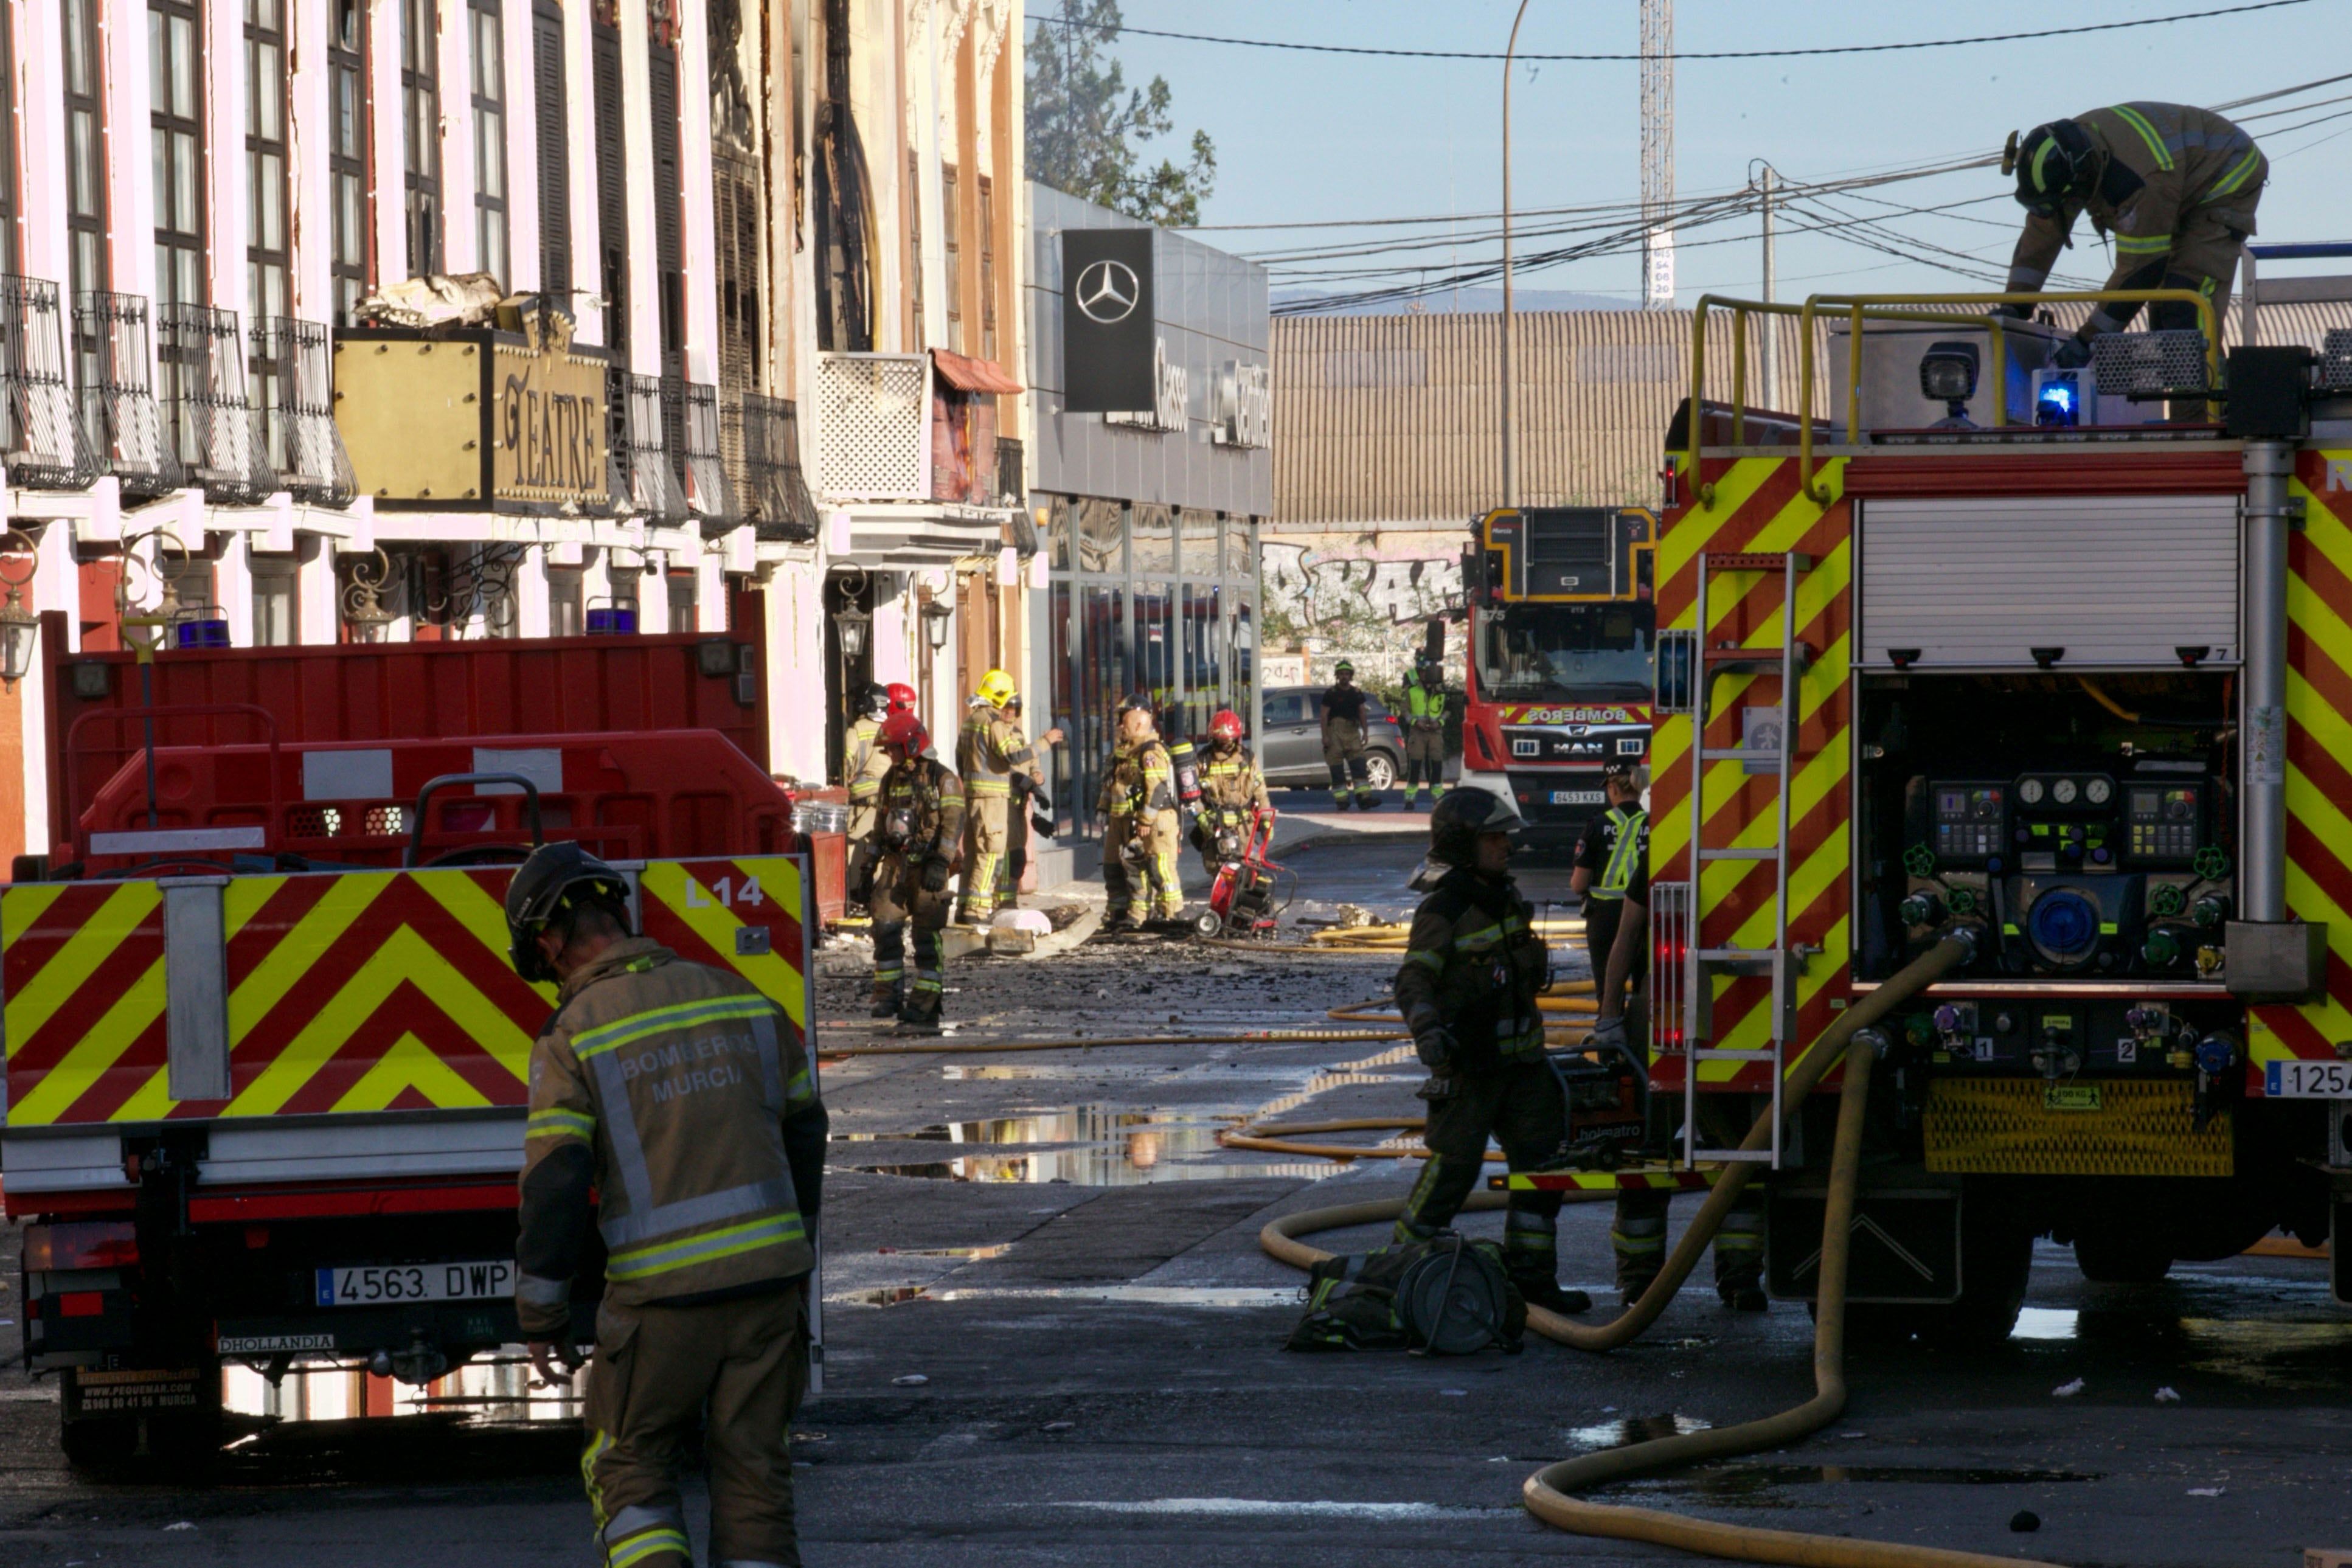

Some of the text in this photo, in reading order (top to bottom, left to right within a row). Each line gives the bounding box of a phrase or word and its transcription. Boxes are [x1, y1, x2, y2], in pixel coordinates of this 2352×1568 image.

[504, 364, 597, 493] TEATRE
[1479, 610, 1505, 622] E75
[2216, 649, 2227, 660] 7
[1553, 743, 1603, 754] MAN
[1556, 792, 1601, 802] 6453 KXS
[685, 876, 763, 908] L14
[1979, 1041, 1988, 1057] 1
[2121, 1042, 2132, 1058] 2
[341, 1269, 425, 1301] 4563
[446, 1266, 508, 1297] DWP
[220, 1336, 332, 1351] DHOLLANDIA
[158, 1393, 196, 1406] MURCIA
